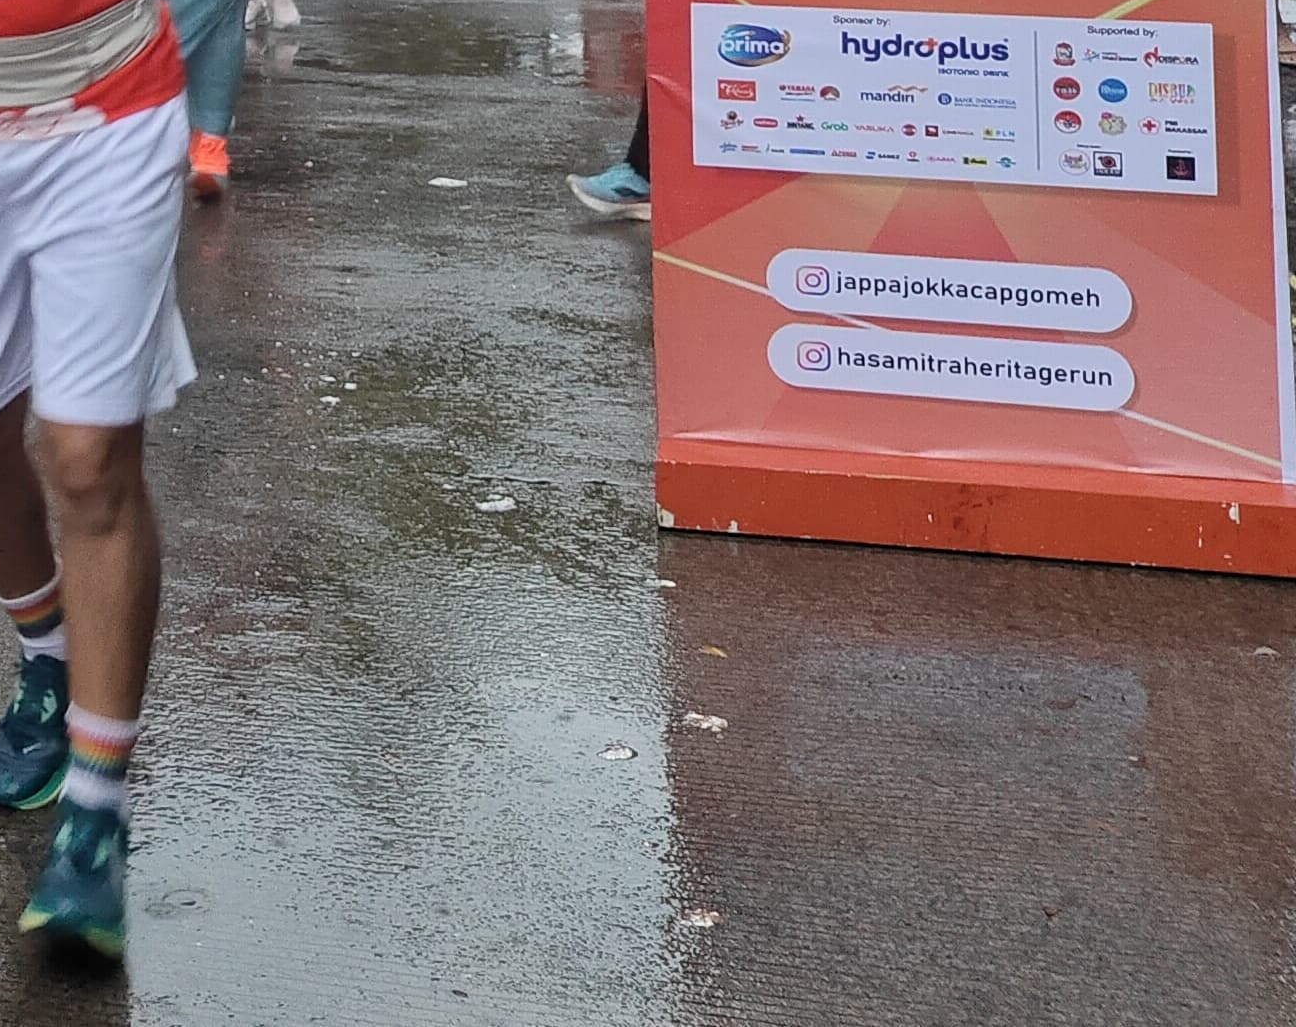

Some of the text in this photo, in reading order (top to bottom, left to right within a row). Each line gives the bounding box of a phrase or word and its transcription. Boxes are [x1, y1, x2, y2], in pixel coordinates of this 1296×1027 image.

[833, 15, 873, 25] Sponsor
[1087, 25, 1140, 37] Supported
[721, 36, 785, 55] prima
[841, 31, 1010, 66] hydroplus
[938, 68, 979, 77] ISOTONIC
[860, 90, 914, 103] mandiri
[821, 121, 849, 132] Grab
[836, 271, 1101, 308] jappajokkacapgomeh
[838, 346, 1113, 387] hasamitraheritagerun
